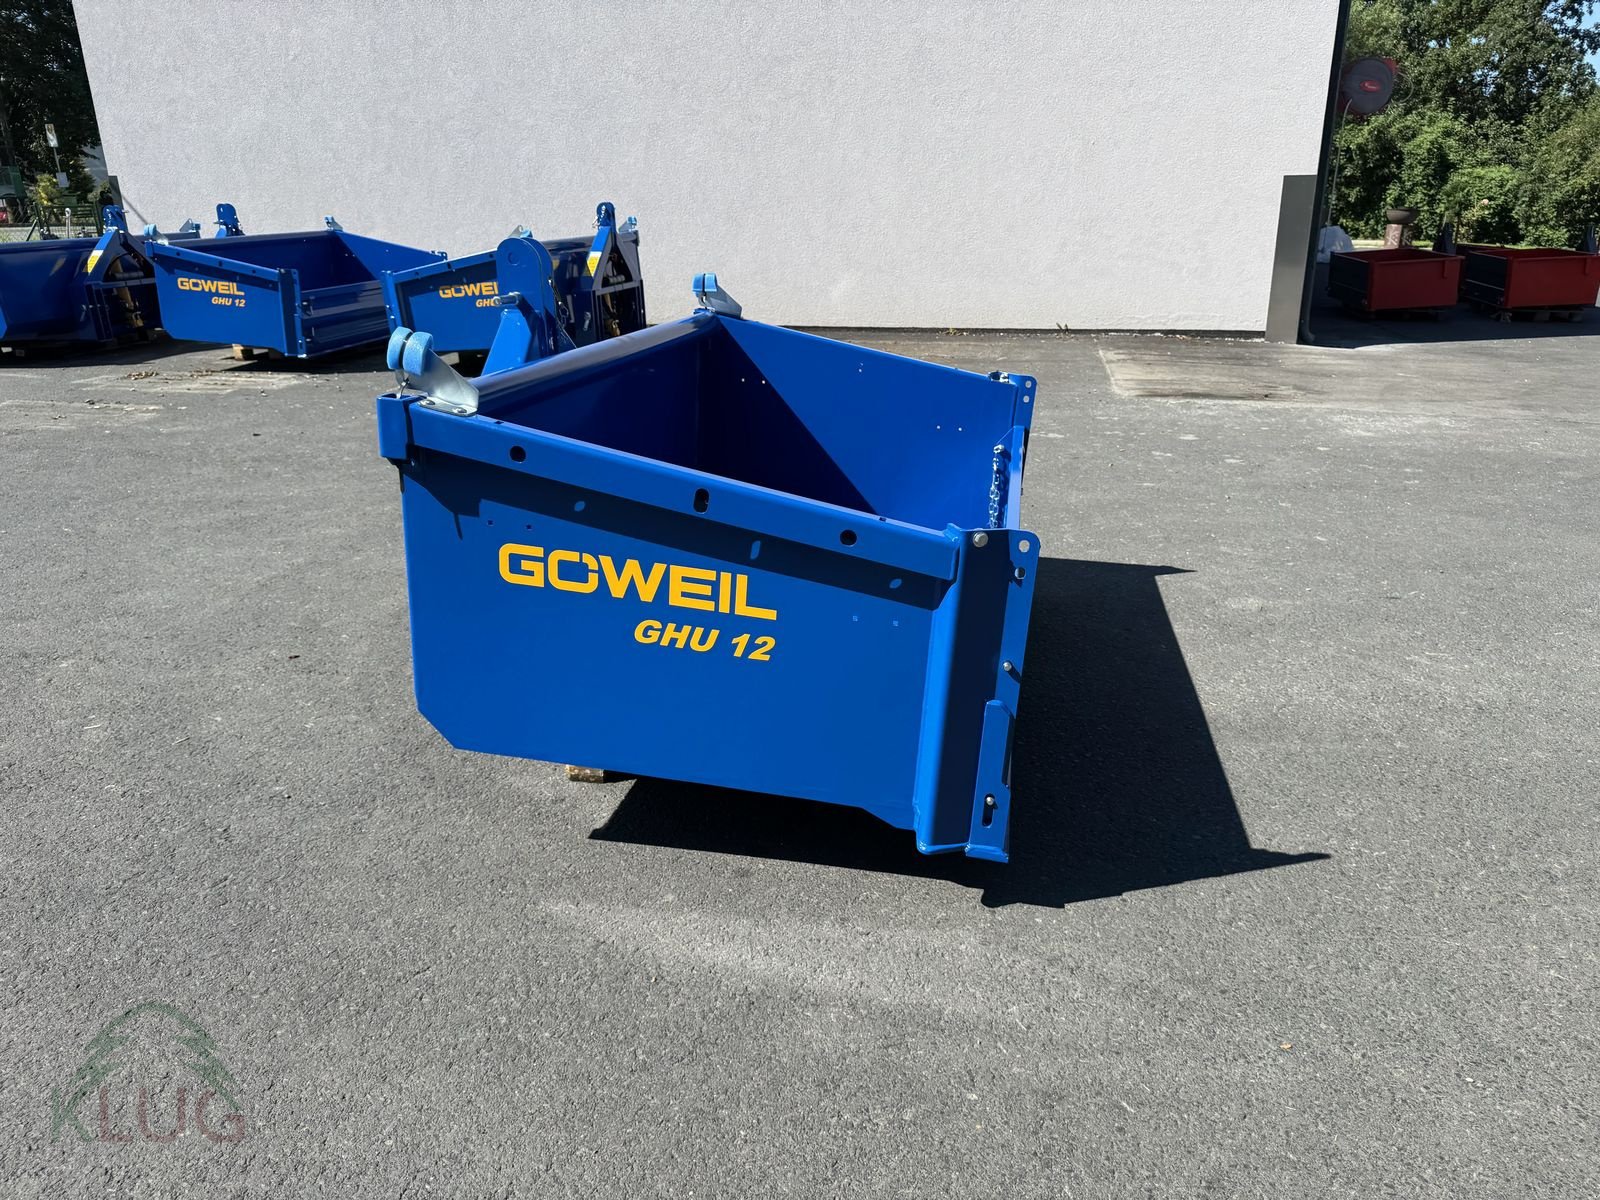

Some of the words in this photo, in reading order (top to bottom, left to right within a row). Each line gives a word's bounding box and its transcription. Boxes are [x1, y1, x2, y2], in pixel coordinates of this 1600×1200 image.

[211, 296, 232, 306] GHU
[234, 299, 246, 307] 12
[439, 281, 499, 298] GOWEI
[499, 543, 777, 621] GOWEIL
[634, 620, 720, 652] GHU
[731, 633, 776, 661] 12
